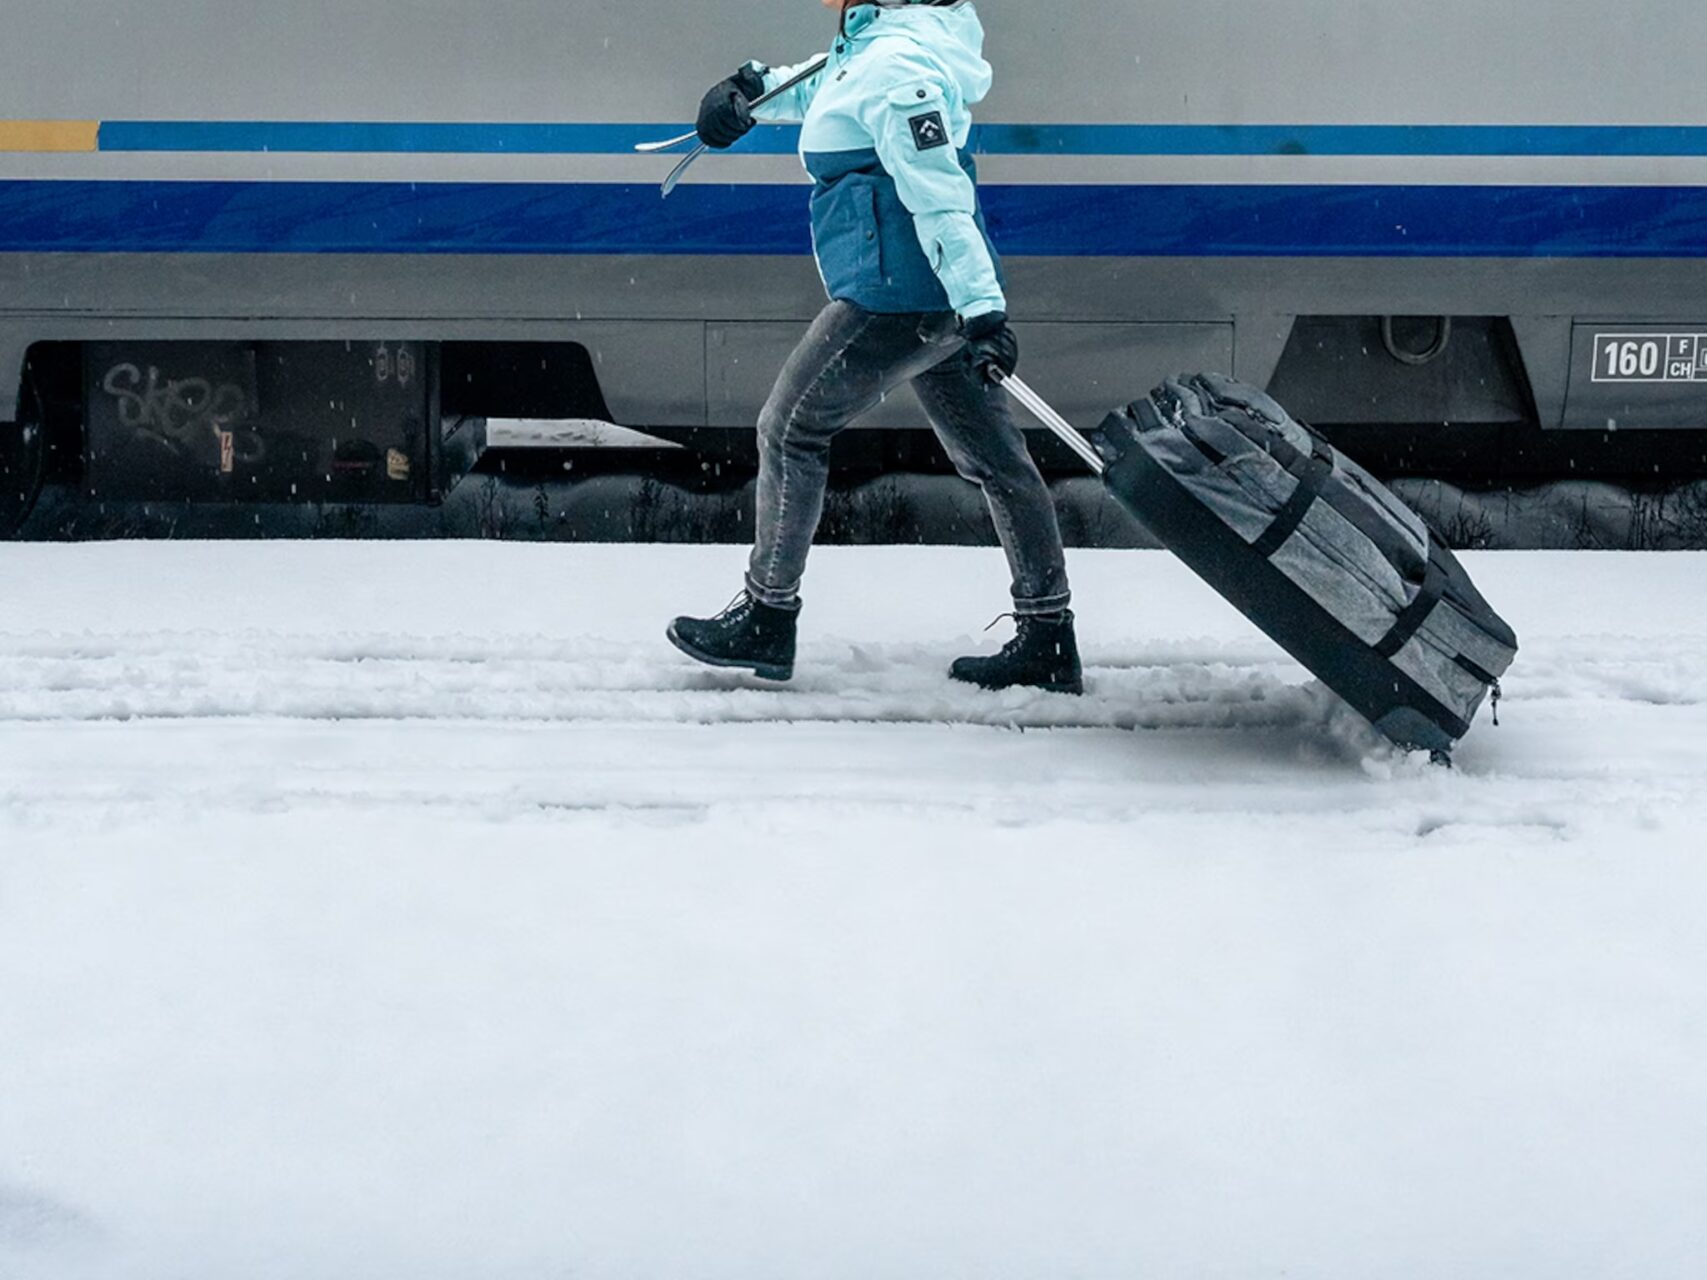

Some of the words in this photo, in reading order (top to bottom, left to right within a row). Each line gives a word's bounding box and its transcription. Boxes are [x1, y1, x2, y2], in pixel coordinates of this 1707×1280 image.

[1679, 339, 1689, 355] F
[1604, 341, 1658, 376] 160
[1670, 362, 1692, 377] CH
